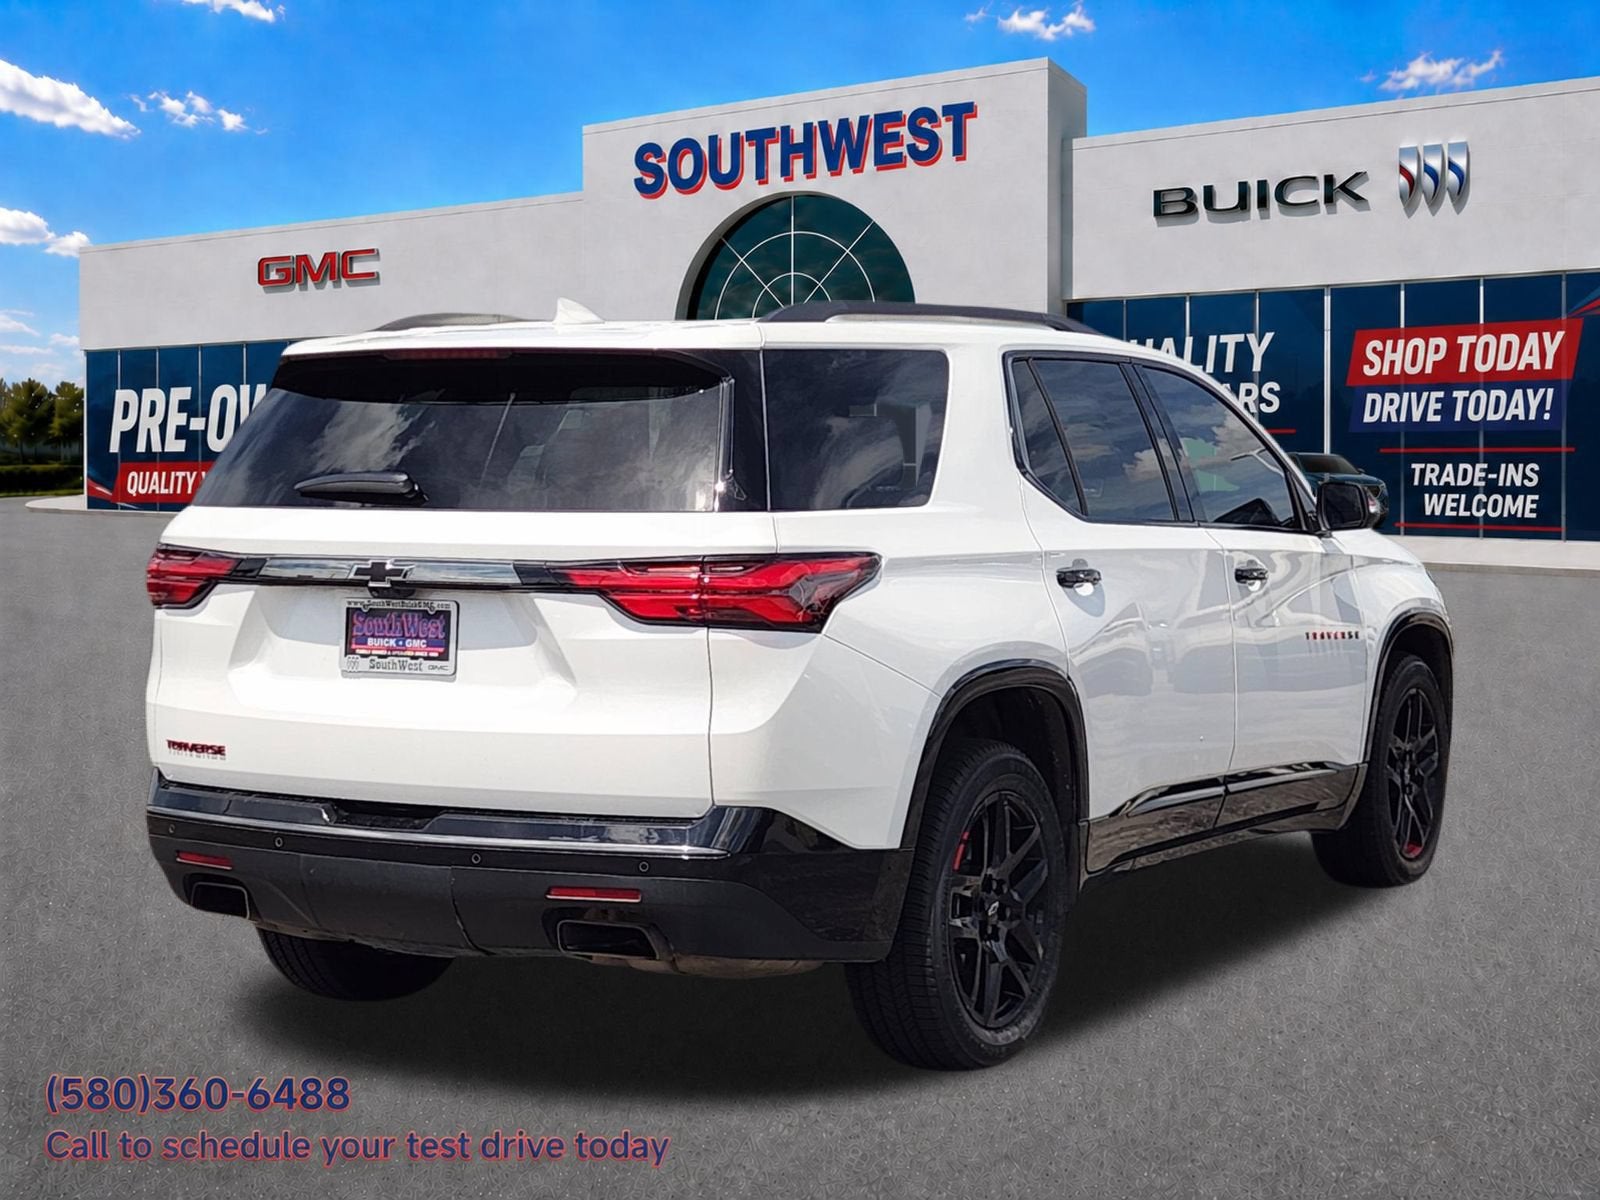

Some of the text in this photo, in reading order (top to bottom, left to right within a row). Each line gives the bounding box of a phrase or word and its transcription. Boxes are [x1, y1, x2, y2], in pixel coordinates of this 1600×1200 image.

[633, 101, 977, 199] SOUTHWEST
[1153, 171, 1369, 220] BUICK
[257, 248, 380, 290] GMC
[1362, 331, 1565, 377] SHOP TODAY
[1362, 388, 1554, 423] DRIVE TODAY!
[126, 471, 195, 495] QUALITY
[1411, 463, 1540, 488] TRADE-INS
[1423, 493, 1540, 519] WELCOME
[367, 637, 428, 648] BUICK GMC
